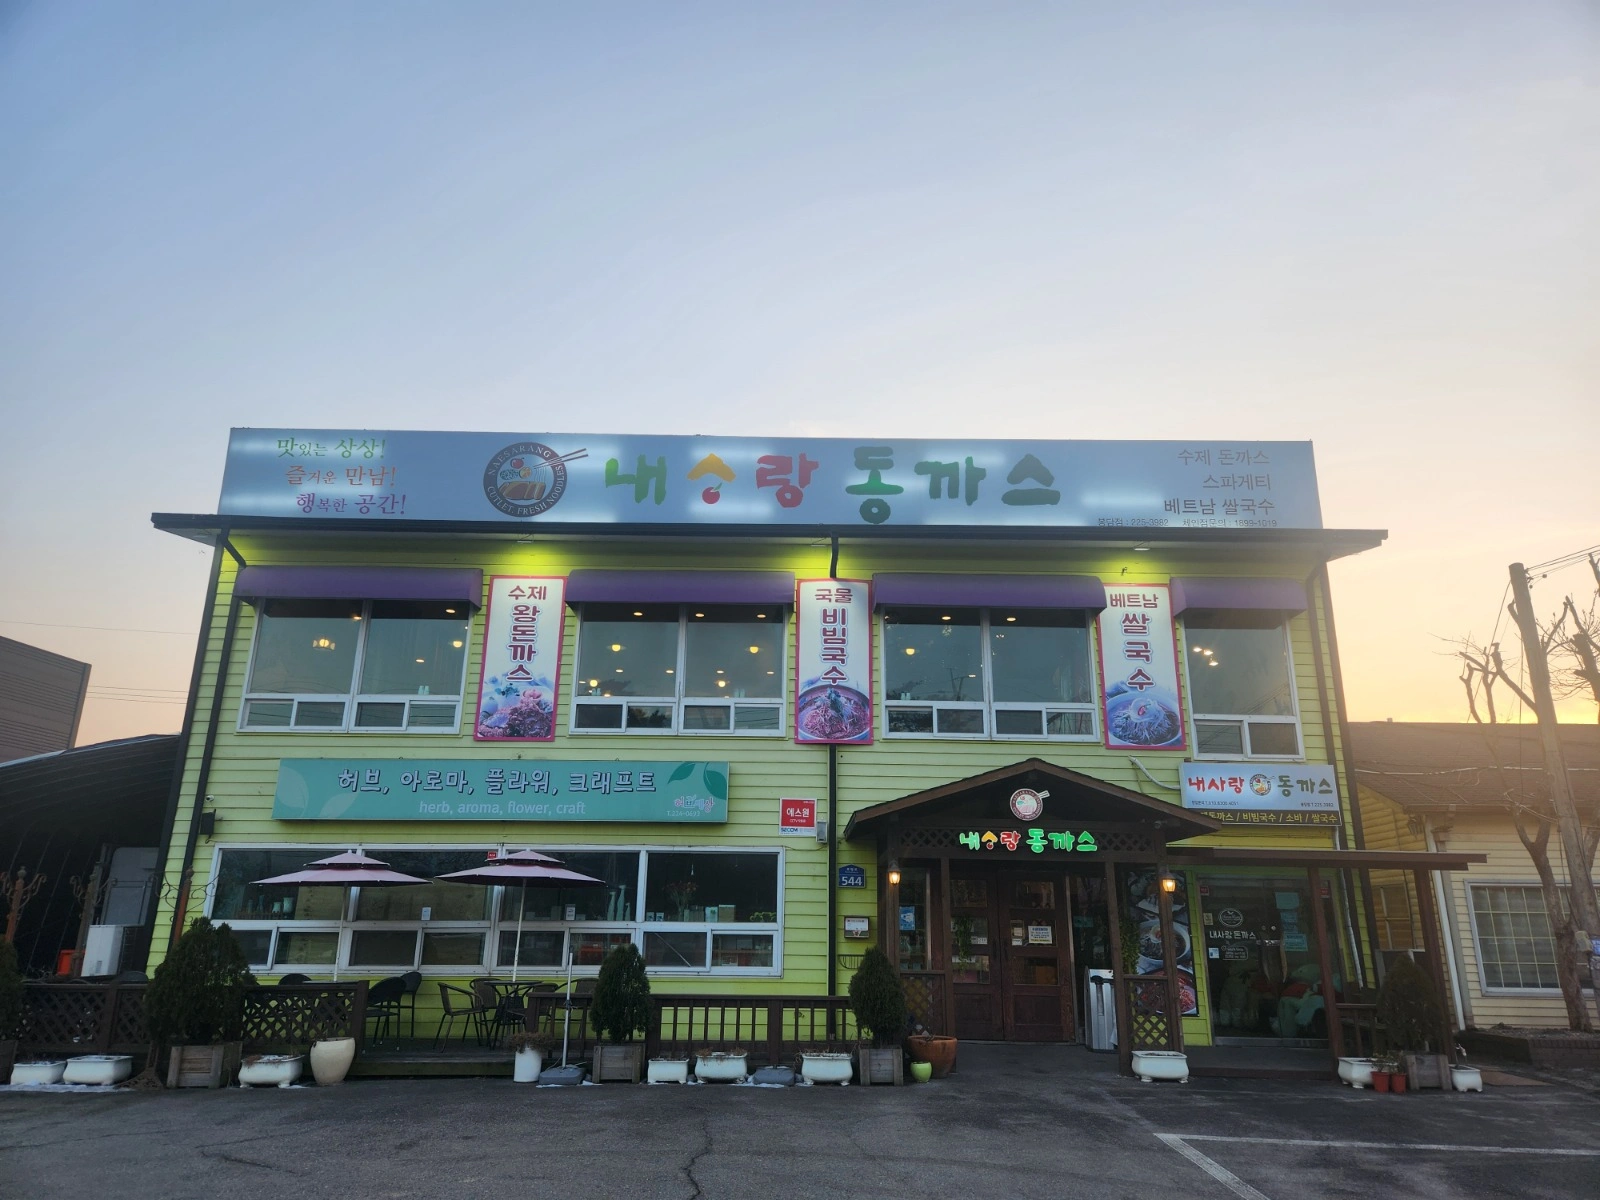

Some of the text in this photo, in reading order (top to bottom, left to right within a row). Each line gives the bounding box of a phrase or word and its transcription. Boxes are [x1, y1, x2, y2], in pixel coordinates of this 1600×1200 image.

[277, 437, 386, 459] 맛있는 상상!
[1177, 449, 1271, 467] 수제 돈까스
[488, 444, 552, 476] NAESARANG
[285, 465, 396, 487] 즐거운 만남!
[845, 446, 1061, 525] 동까스
[1202, 473, 1272, 491] 스파게티
[517, 502, 547, 516] FRESH
[546, 465, 565, 505] NOODLES
[296, 492, 406, 515] 행복한 공간!
[1164, 498, 1275, 516] 베트남 쌀국수
[1131, 519, 1169, 527] 225-3982
[508, 585, 547, 601] 수제
[814, 588, 853, 604] 국물
[1109, 593, 1159, 609] 베트남
[506, 604, 541, 681] 왕돈까스
[820, 607, 847, 685] 비빔국수
[1121, 613, 1155, 691] 쌀국수
[338, 768, 657, 796] 허브, 아로마, 플라워, 크래프트
[1187, 776, 1245, 794] 내사랑
[1277, 775, 1333, 798] 동까스
[419, 801, 586, 816] herb, aroma, flower, craft
[786, 808, 810, 818] 에스원
[1242, 813, 1277, 823] 비빔국수
[1285, 813, 1302, 823] 소바
[1311, 813, 1338, 824] 쌀국수
[1026, 828, 1098, 853] 동까스
[841, 876, 863, 886] 544
[1209, 930, 1232, 939] 내사랑
